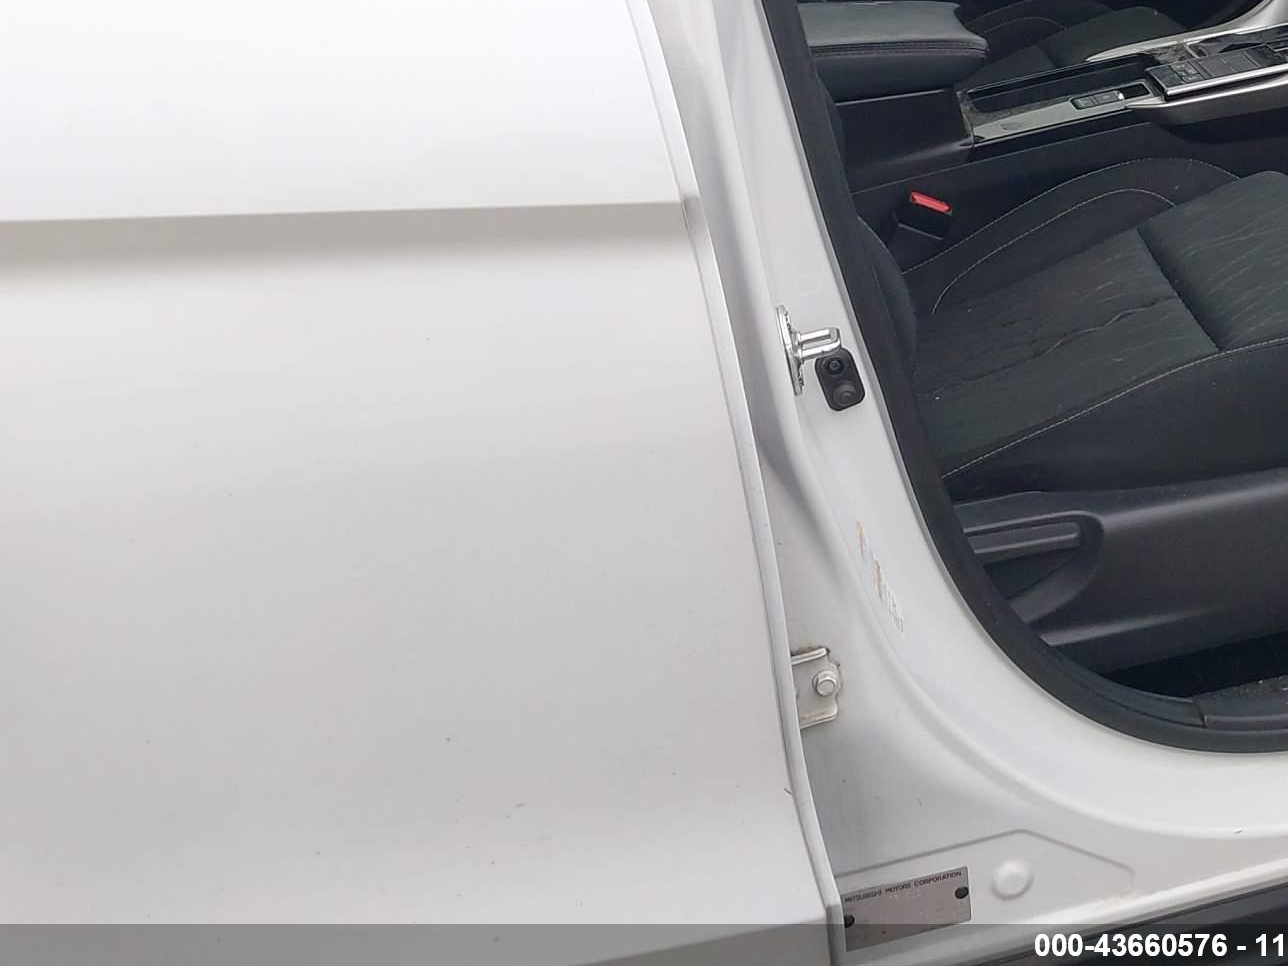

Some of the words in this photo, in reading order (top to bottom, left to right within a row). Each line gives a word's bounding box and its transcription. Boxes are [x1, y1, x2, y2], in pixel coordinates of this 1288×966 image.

[845, 889, 882, 903] MITSUBISHI
[885, 882, 912, 894] MOTORS
[914, 871, 962, 887] CORPORATION
